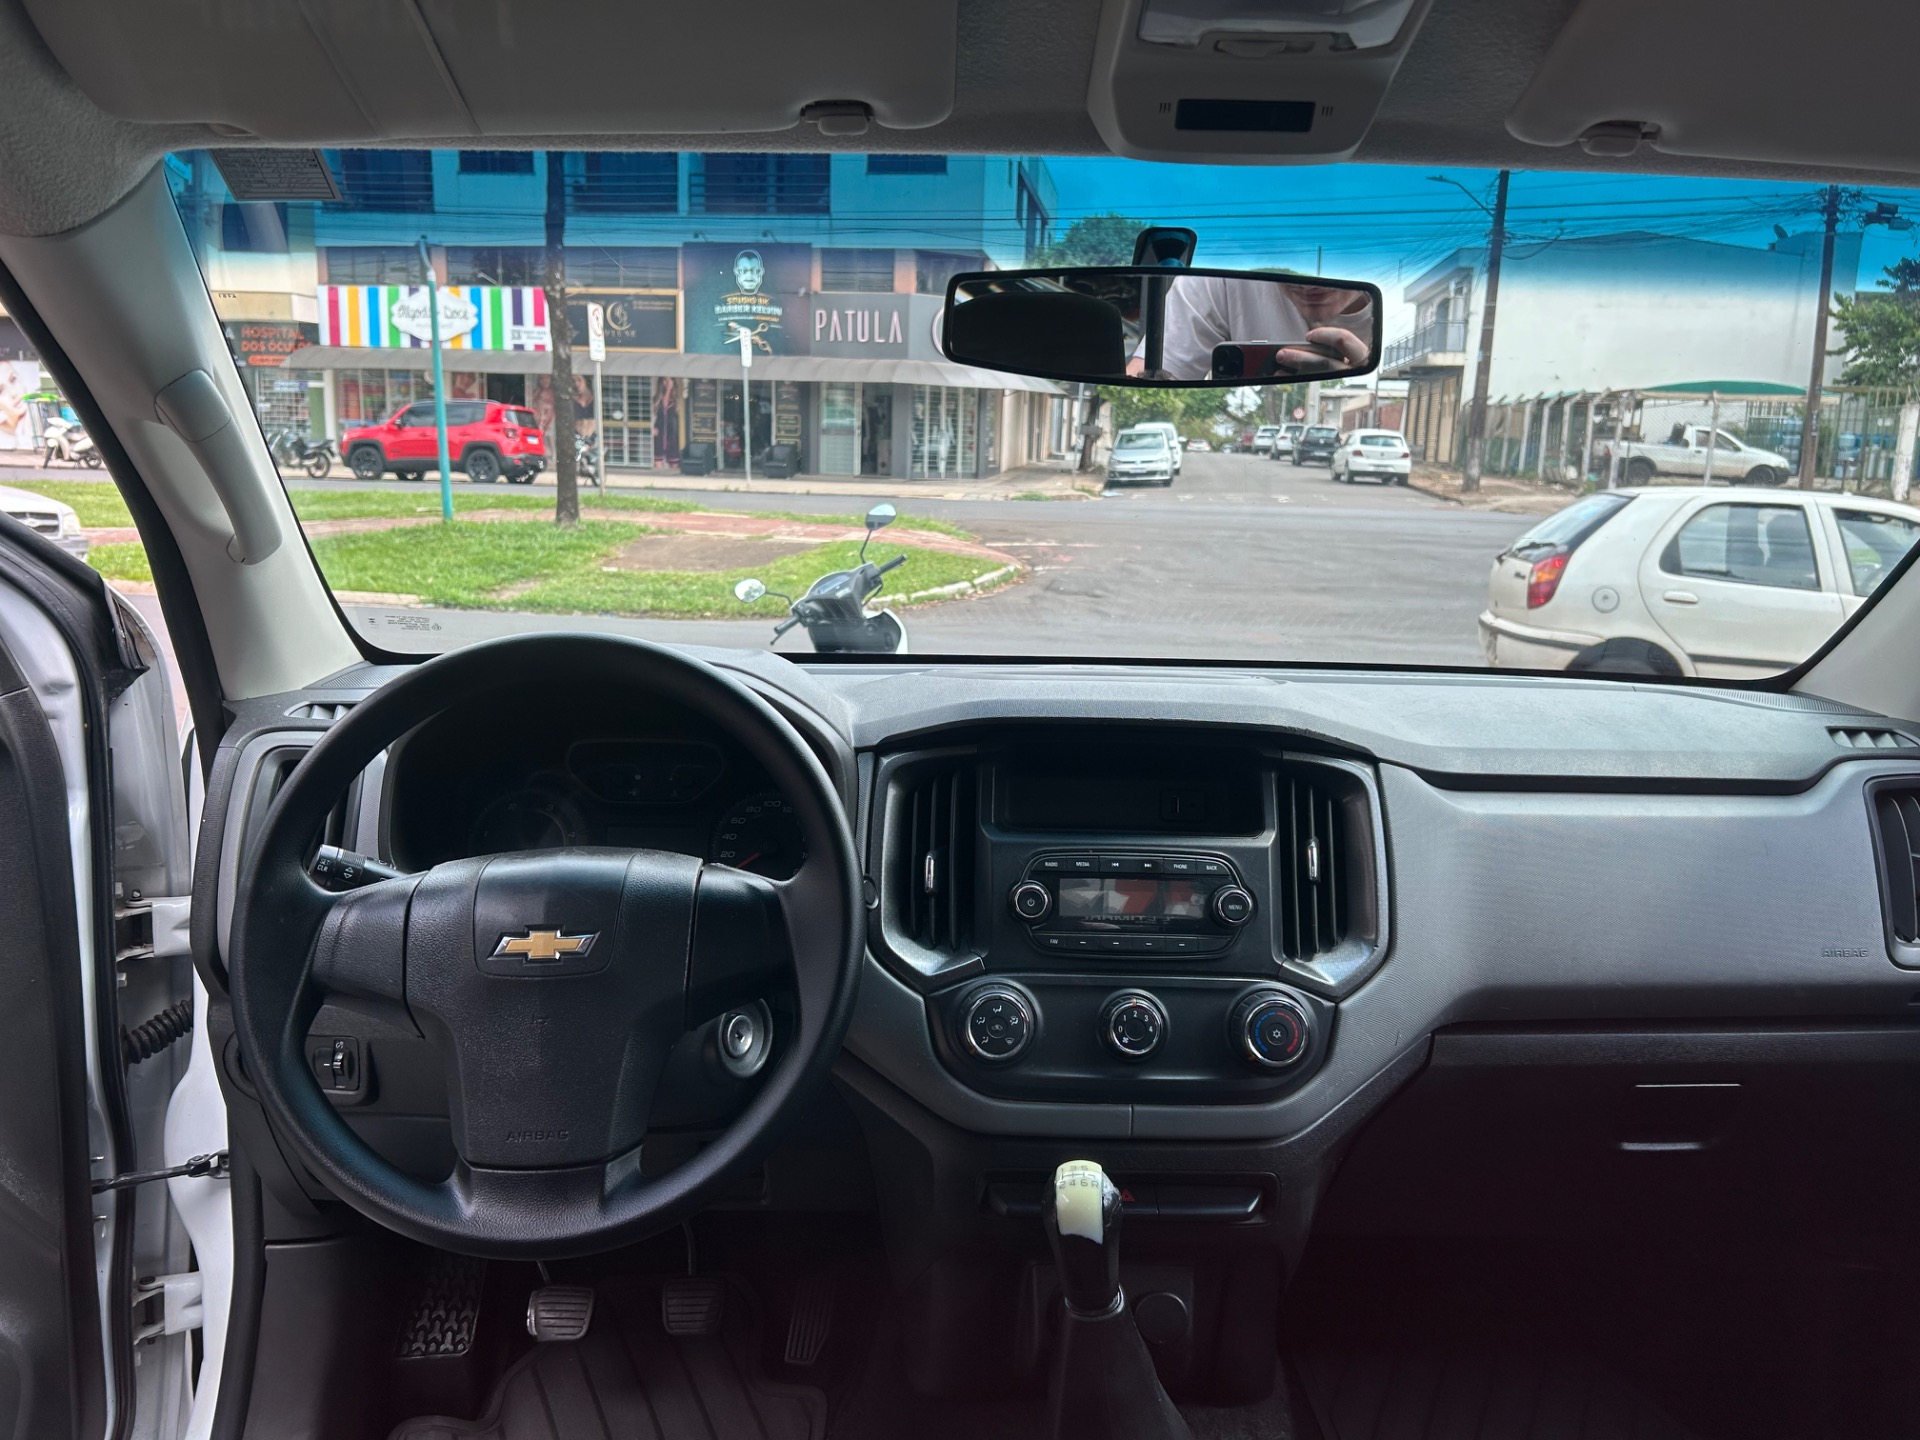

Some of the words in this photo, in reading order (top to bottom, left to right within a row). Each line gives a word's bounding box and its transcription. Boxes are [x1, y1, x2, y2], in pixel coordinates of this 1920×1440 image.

[815, 309, 903, 343] PATULA
[241, 340, 266, 353] DOS
[763, 800, 781, 808] 100
[730, 817, 746, 825] 60
[722, 833, 738, 841] 40
[720, 850, 736, 858] 20
[1044, 860, 1059, 868] RADIO
[1075, 860, 1091, 868] MEDIA
[1173, 862, 1188, 870] PHONE
[1227, 903, 1243, 911] MENU
[1821, 948, 1869, 958] AIRBAG
[1118, 1025, 1123, 1033] 0
[1122, 1014, 1127, 1022] 1
[1132, 1010, 1138, 1018] 2
[1144, 1014, 1149, 1022] 3
[1148, 1025, 1153, 1033] 4
[506, 1130, 569, 1142] AIRBAG
[1059, 1180, 1066, 1189] 2
[1069, 1179, 1076, 1187] 4
[1080, 1178, 1089, 1187] 6
[1091, 1180, 1099, 1189] R
